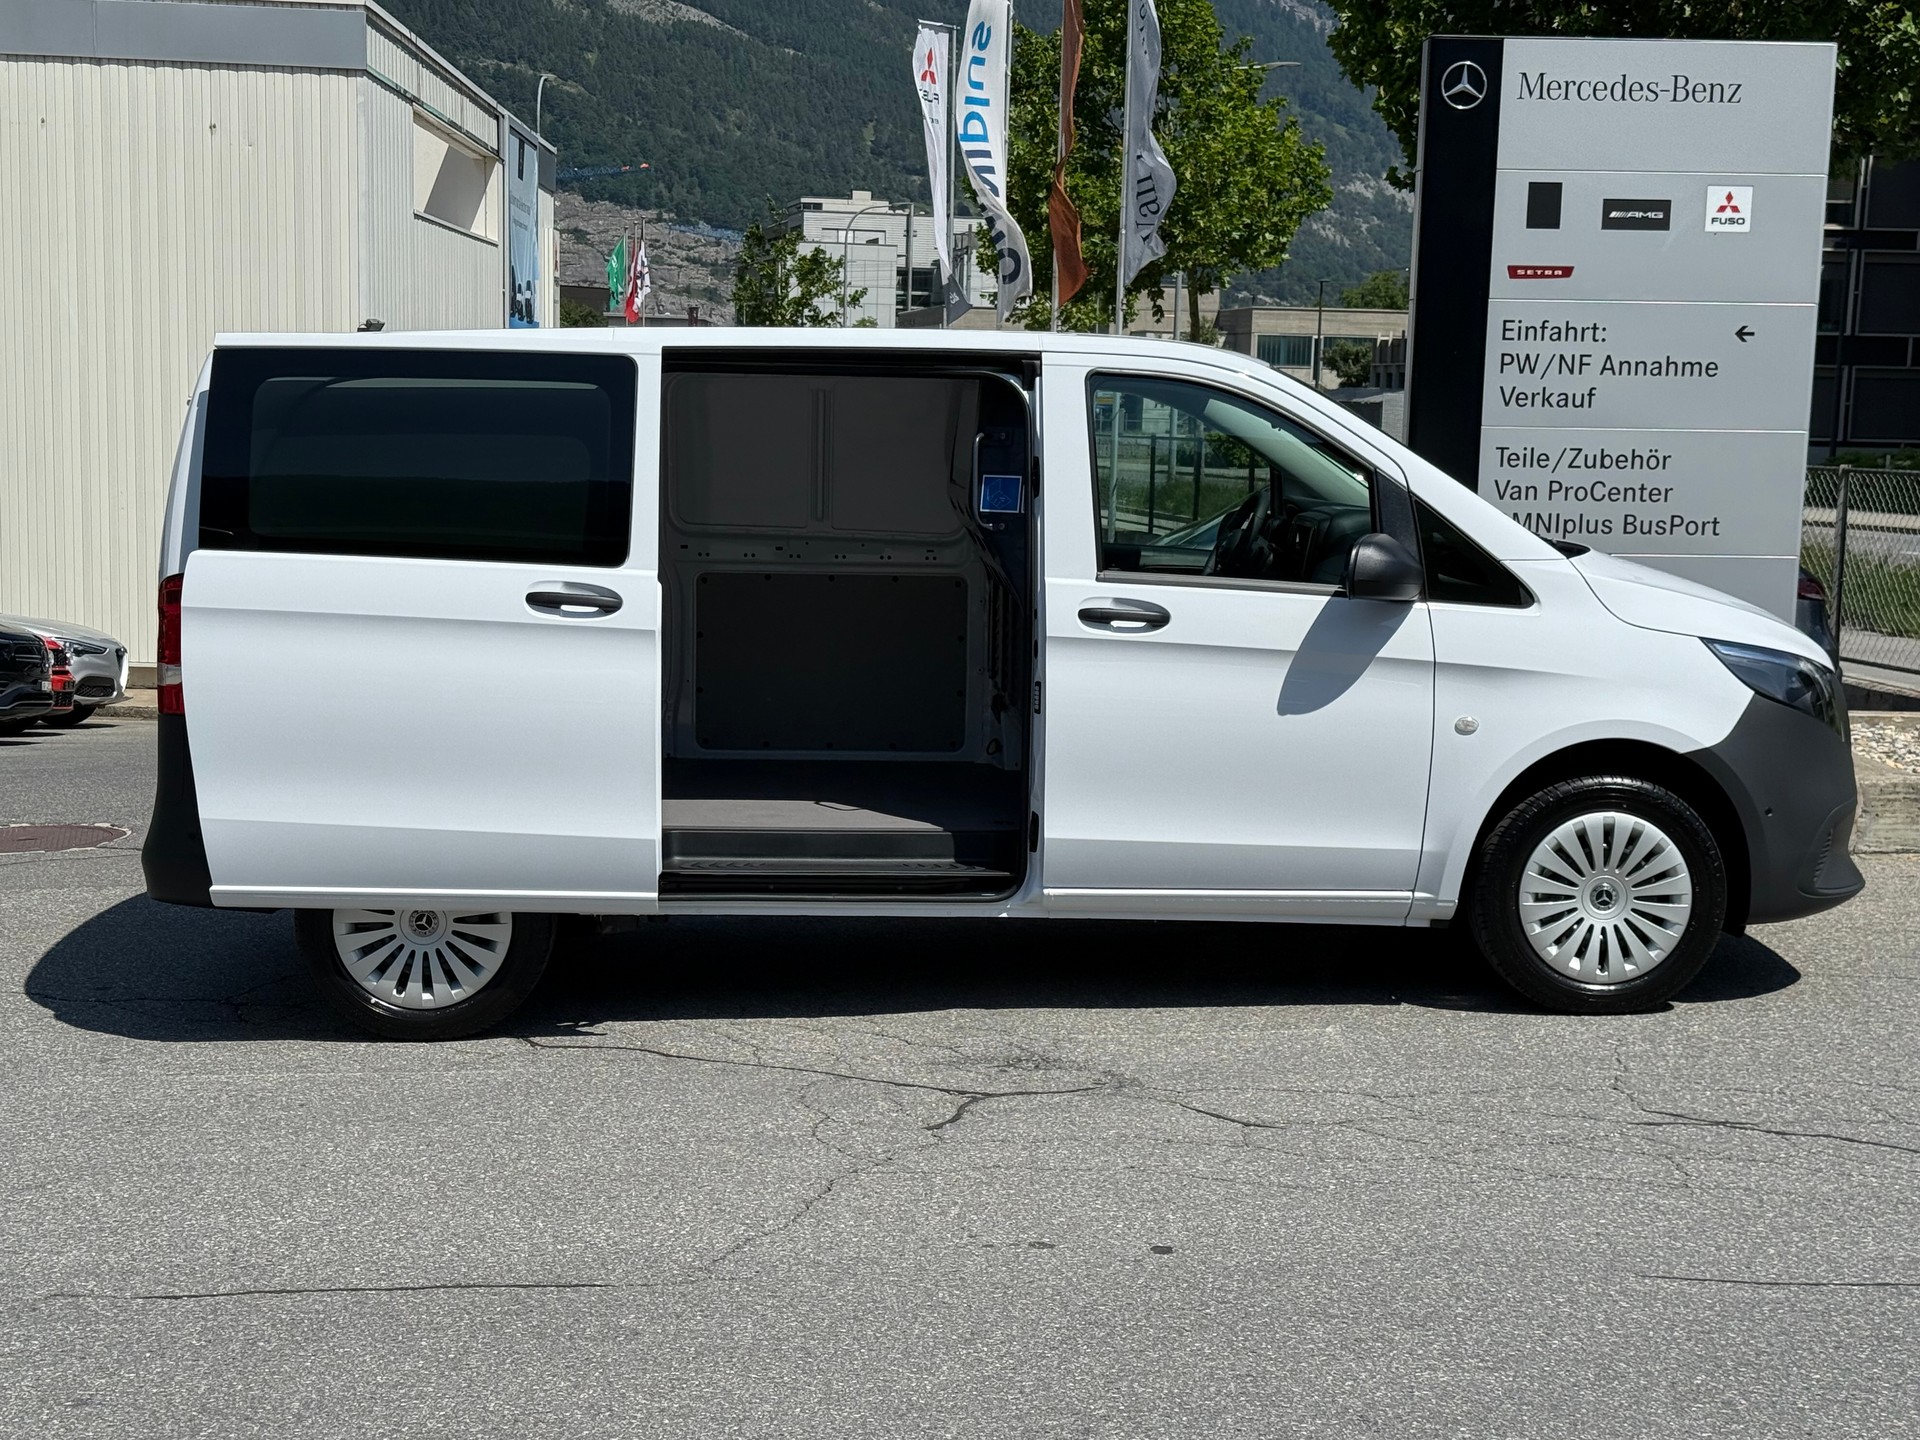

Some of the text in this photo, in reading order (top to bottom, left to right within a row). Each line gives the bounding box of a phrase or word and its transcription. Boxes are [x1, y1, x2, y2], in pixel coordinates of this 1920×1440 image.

[1516, 71, 1743, 104] Mercedes-Benz
[1628, 211, 1664, 219] AMG
[1711, 217, 1745, 226] FUSO
[1501, 319, 1607, 343] Einfahrt:
[1499, 352, 1720, 380] PW/NF Annahme
[1499, 385, 1597, 409] Verkauf
[1495, 446, 1672, 474] Teile/Zubehör
[1494, 479, 1674, 503] Van ProCenter
[1511, 512, 1721, 540] MNIplus BusPort
